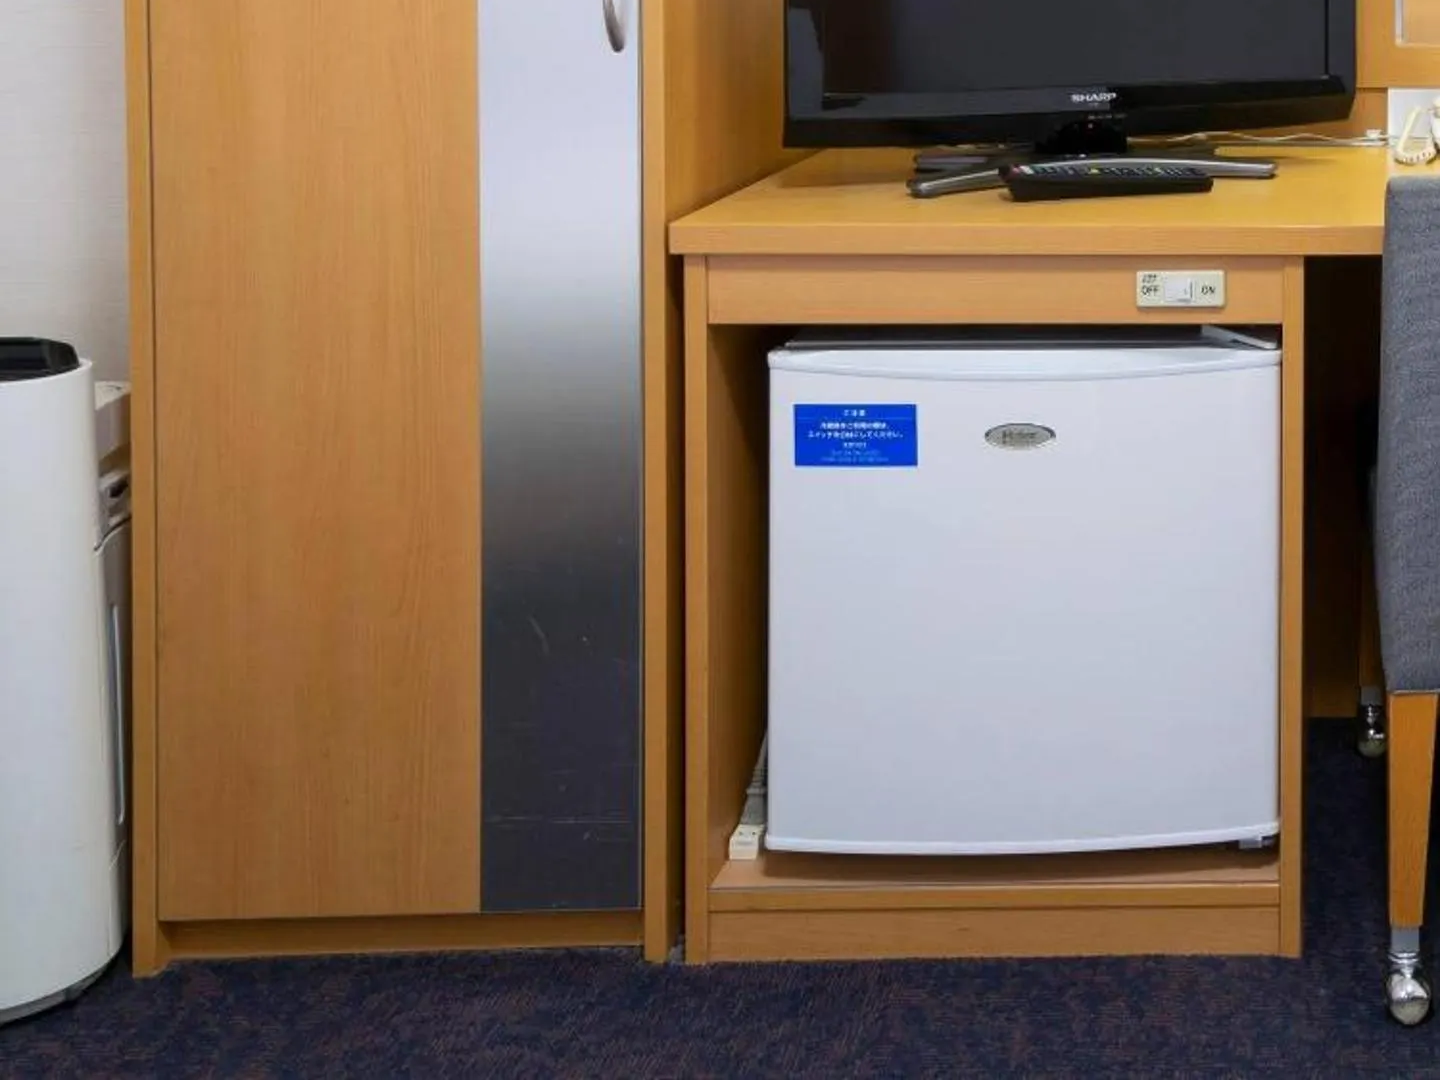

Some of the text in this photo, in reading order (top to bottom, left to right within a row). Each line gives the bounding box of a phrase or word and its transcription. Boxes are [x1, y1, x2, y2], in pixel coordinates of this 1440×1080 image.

[1071, 92, 1117, 102] SHARP
[1141, 284, 1159, 295] OFF
[1200, 285, 1216, 295] ON
